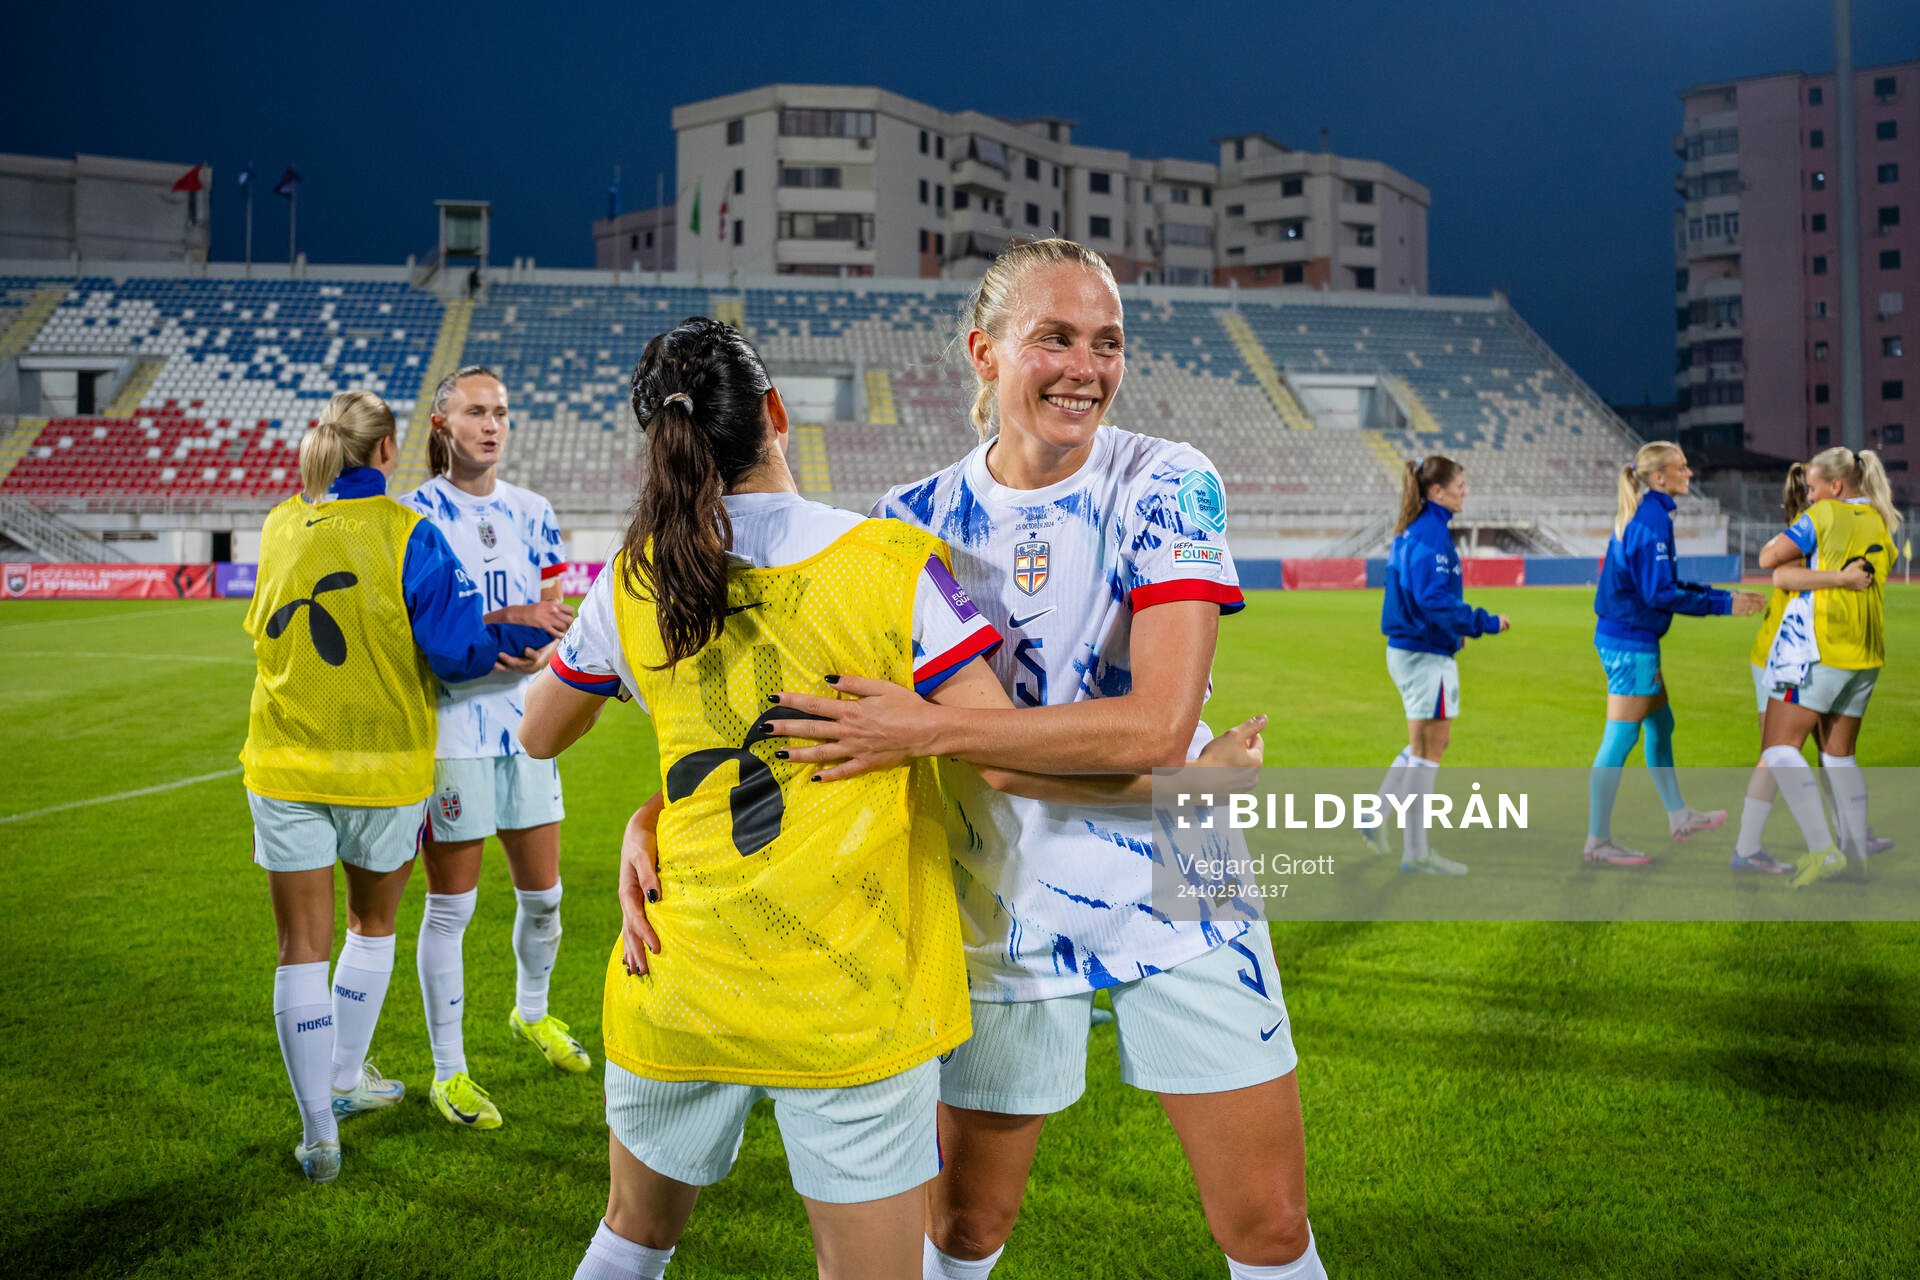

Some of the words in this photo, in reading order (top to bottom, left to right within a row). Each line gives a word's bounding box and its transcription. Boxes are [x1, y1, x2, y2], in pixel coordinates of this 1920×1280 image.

[1014, 638, 1048, 707] 5
[334, 984, 367, 1002] NORGE
[297, 1015, 333, 1033] NORGE
